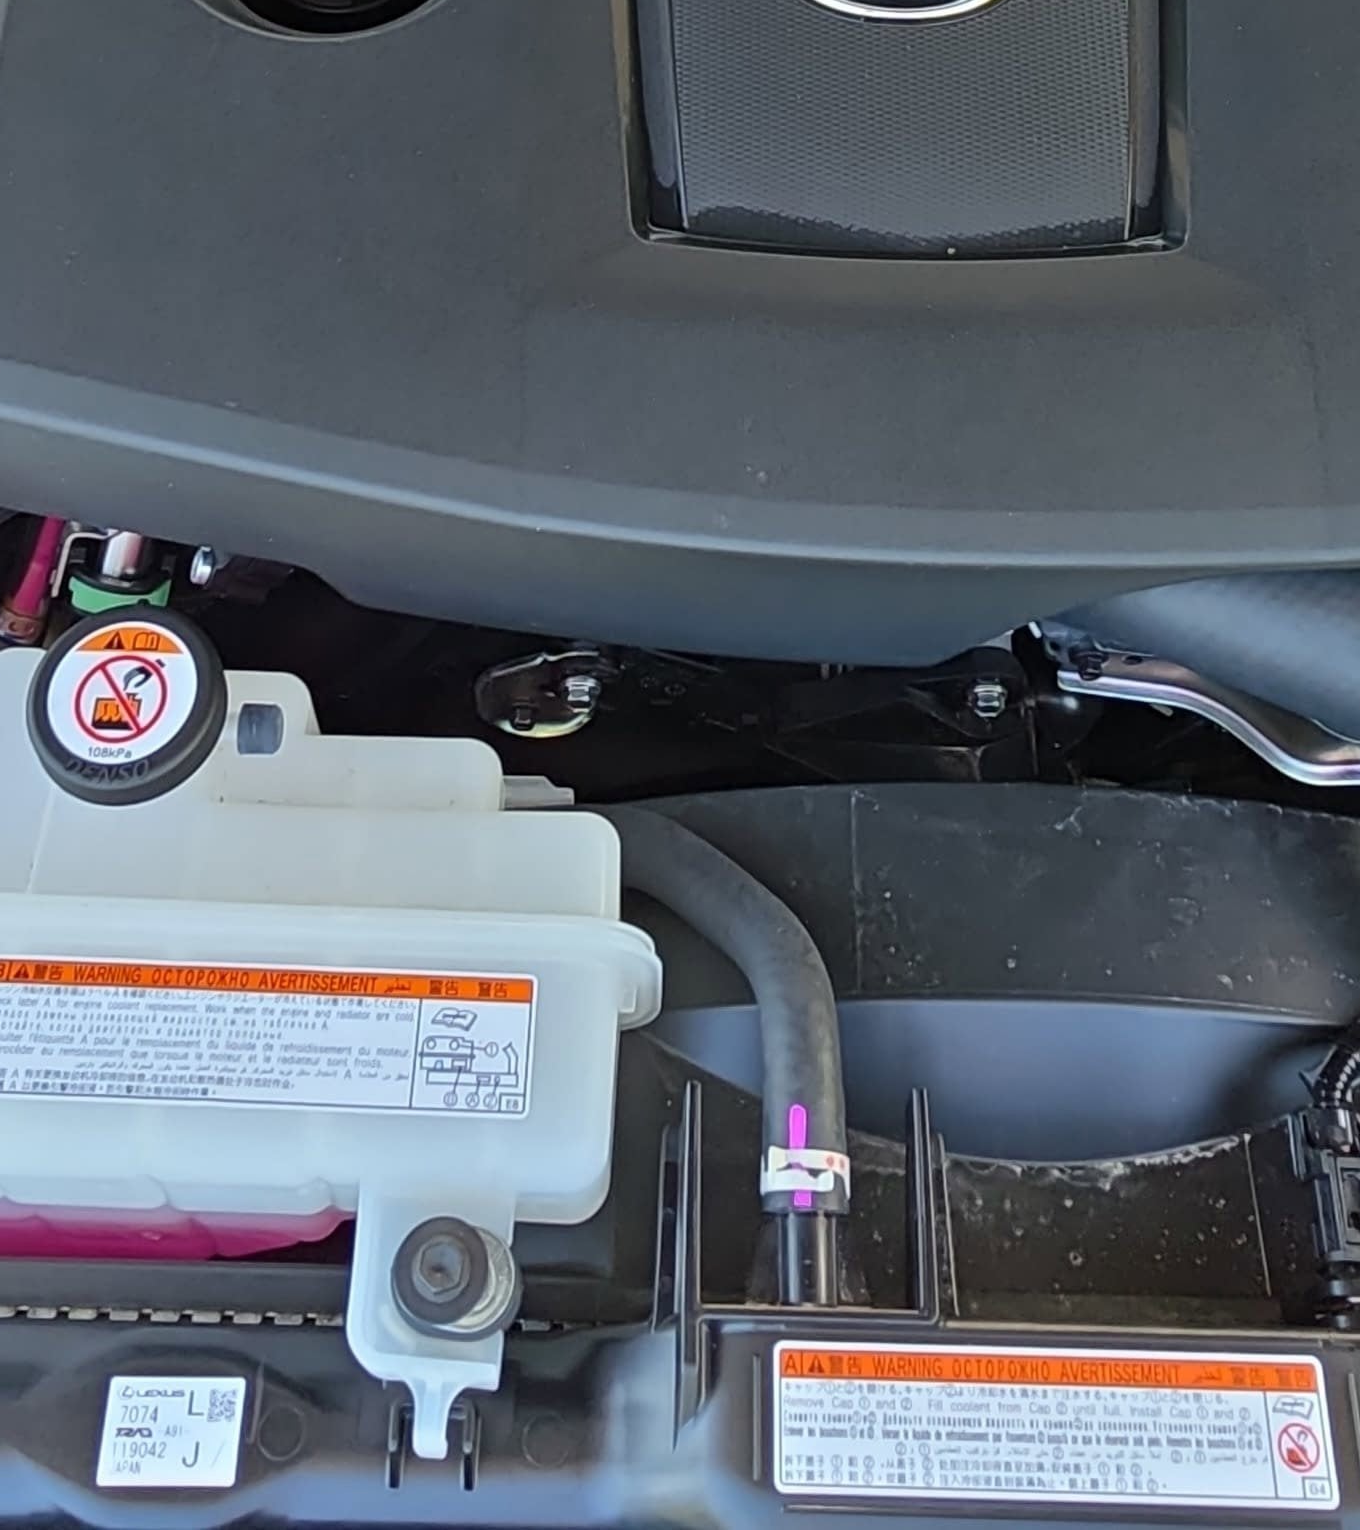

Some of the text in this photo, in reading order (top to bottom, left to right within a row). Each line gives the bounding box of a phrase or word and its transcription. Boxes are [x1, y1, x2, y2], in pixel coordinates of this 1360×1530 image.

[88, 747, 132, 759] 108kPa
[64, 758, 150, 783] DENSO
[72, 965, 141, 984] WARNING
[151, 968, 250, 988] ОСТОРОЖНО
[258, 972, 378, 993] AVERTISSEMENT
[42, 997, 52, 1007] A
[784, 1353, 800, 1371] A
[872, 1356, 943, 1377] WARNING
[951, 1358, 1050, 1381] ОСТОРОЖНО
[1059, 1362, 1181, 1385] AVERTISSEMENT
[121, 1405, 159, 1424] 7074
[137, 1389, 204, 1417] LEXUS L
[783, 1395, 824, 1408] Remove
[831, 1395, 853, 1409] Cap
[875, 1397, 896, 1410] and
[927, 1398, 943, 1411] Fill
[950, 1400, 990, 1413] coolant
[997, 1401, 1021, 1412] from
[1028, 1401, 1051, 1415] Cap
[1168, 1405, 1192, 1419] Cap
[1213, 1407, 1234, 1420] and
[113, 1442, 168, 1459] 119042
[182, 1441, 200, 1468] J
